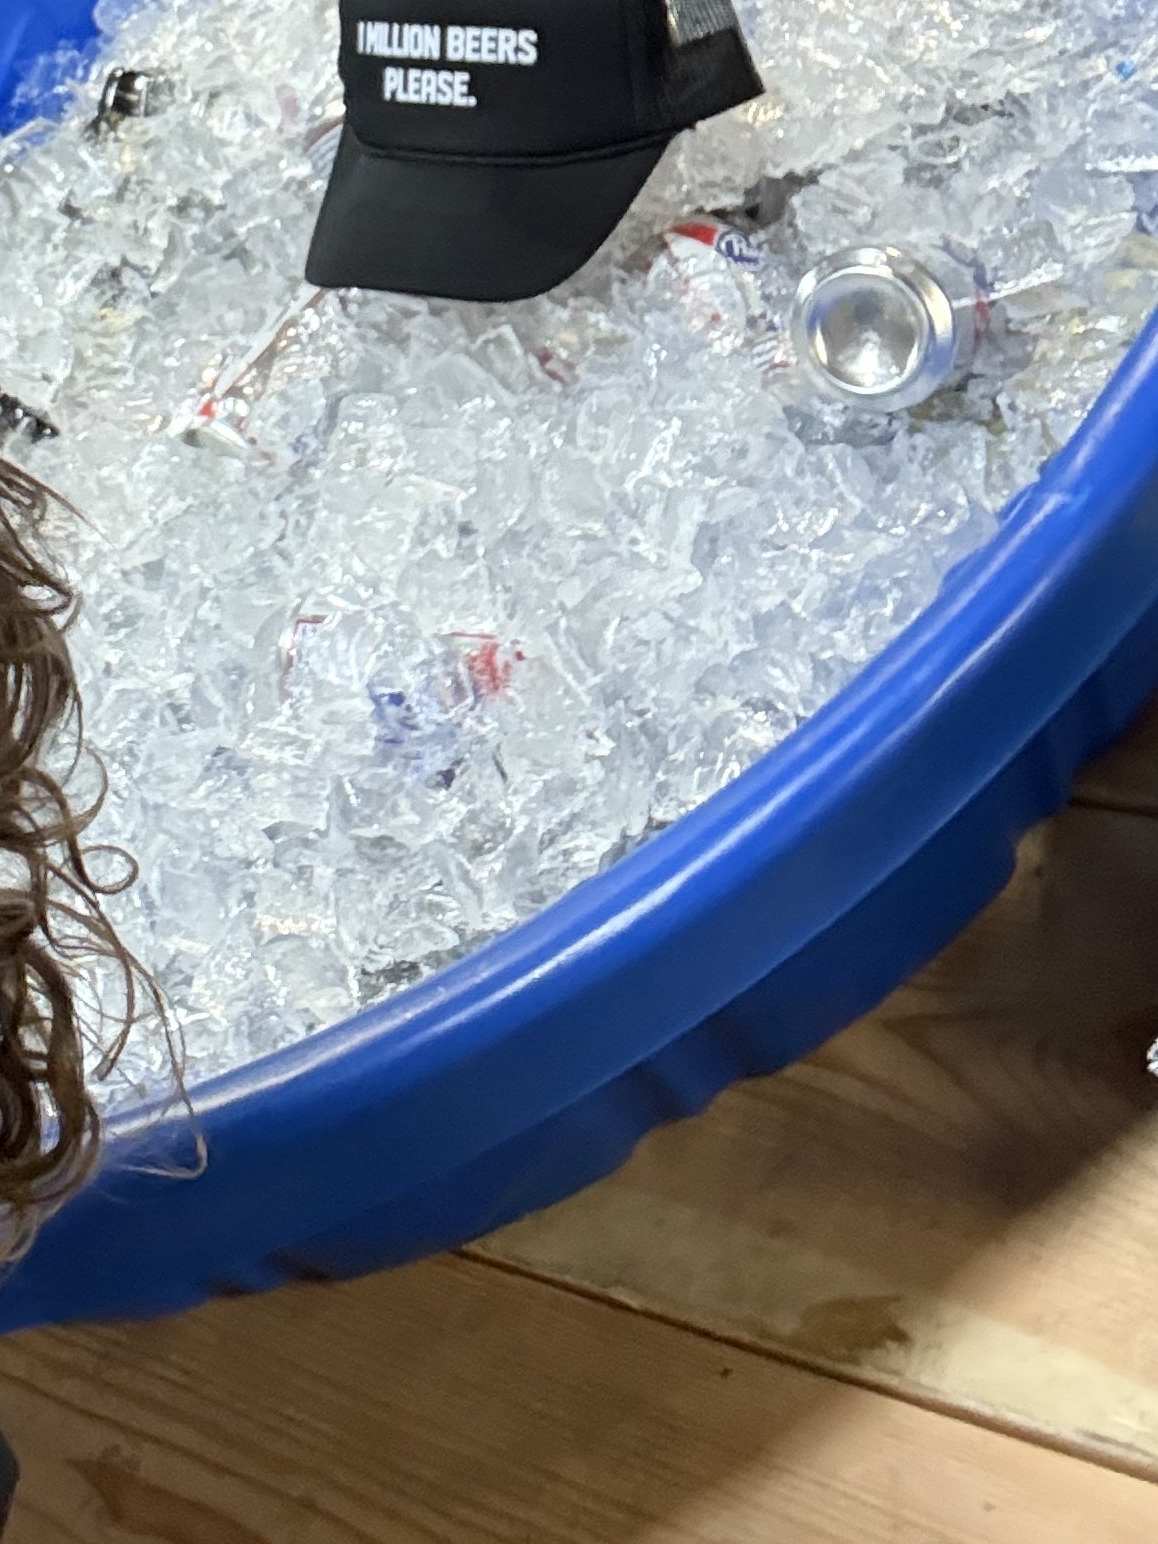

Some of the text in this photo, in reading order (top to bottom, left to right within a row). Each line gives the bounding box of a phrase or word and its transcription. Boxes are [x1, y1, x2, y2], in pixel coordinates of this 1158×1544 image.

[365, 21, 441, 61] MILLION
[446, 25, 538, 66] BEERS
[383, 66, 477, 107] PLEASE.
